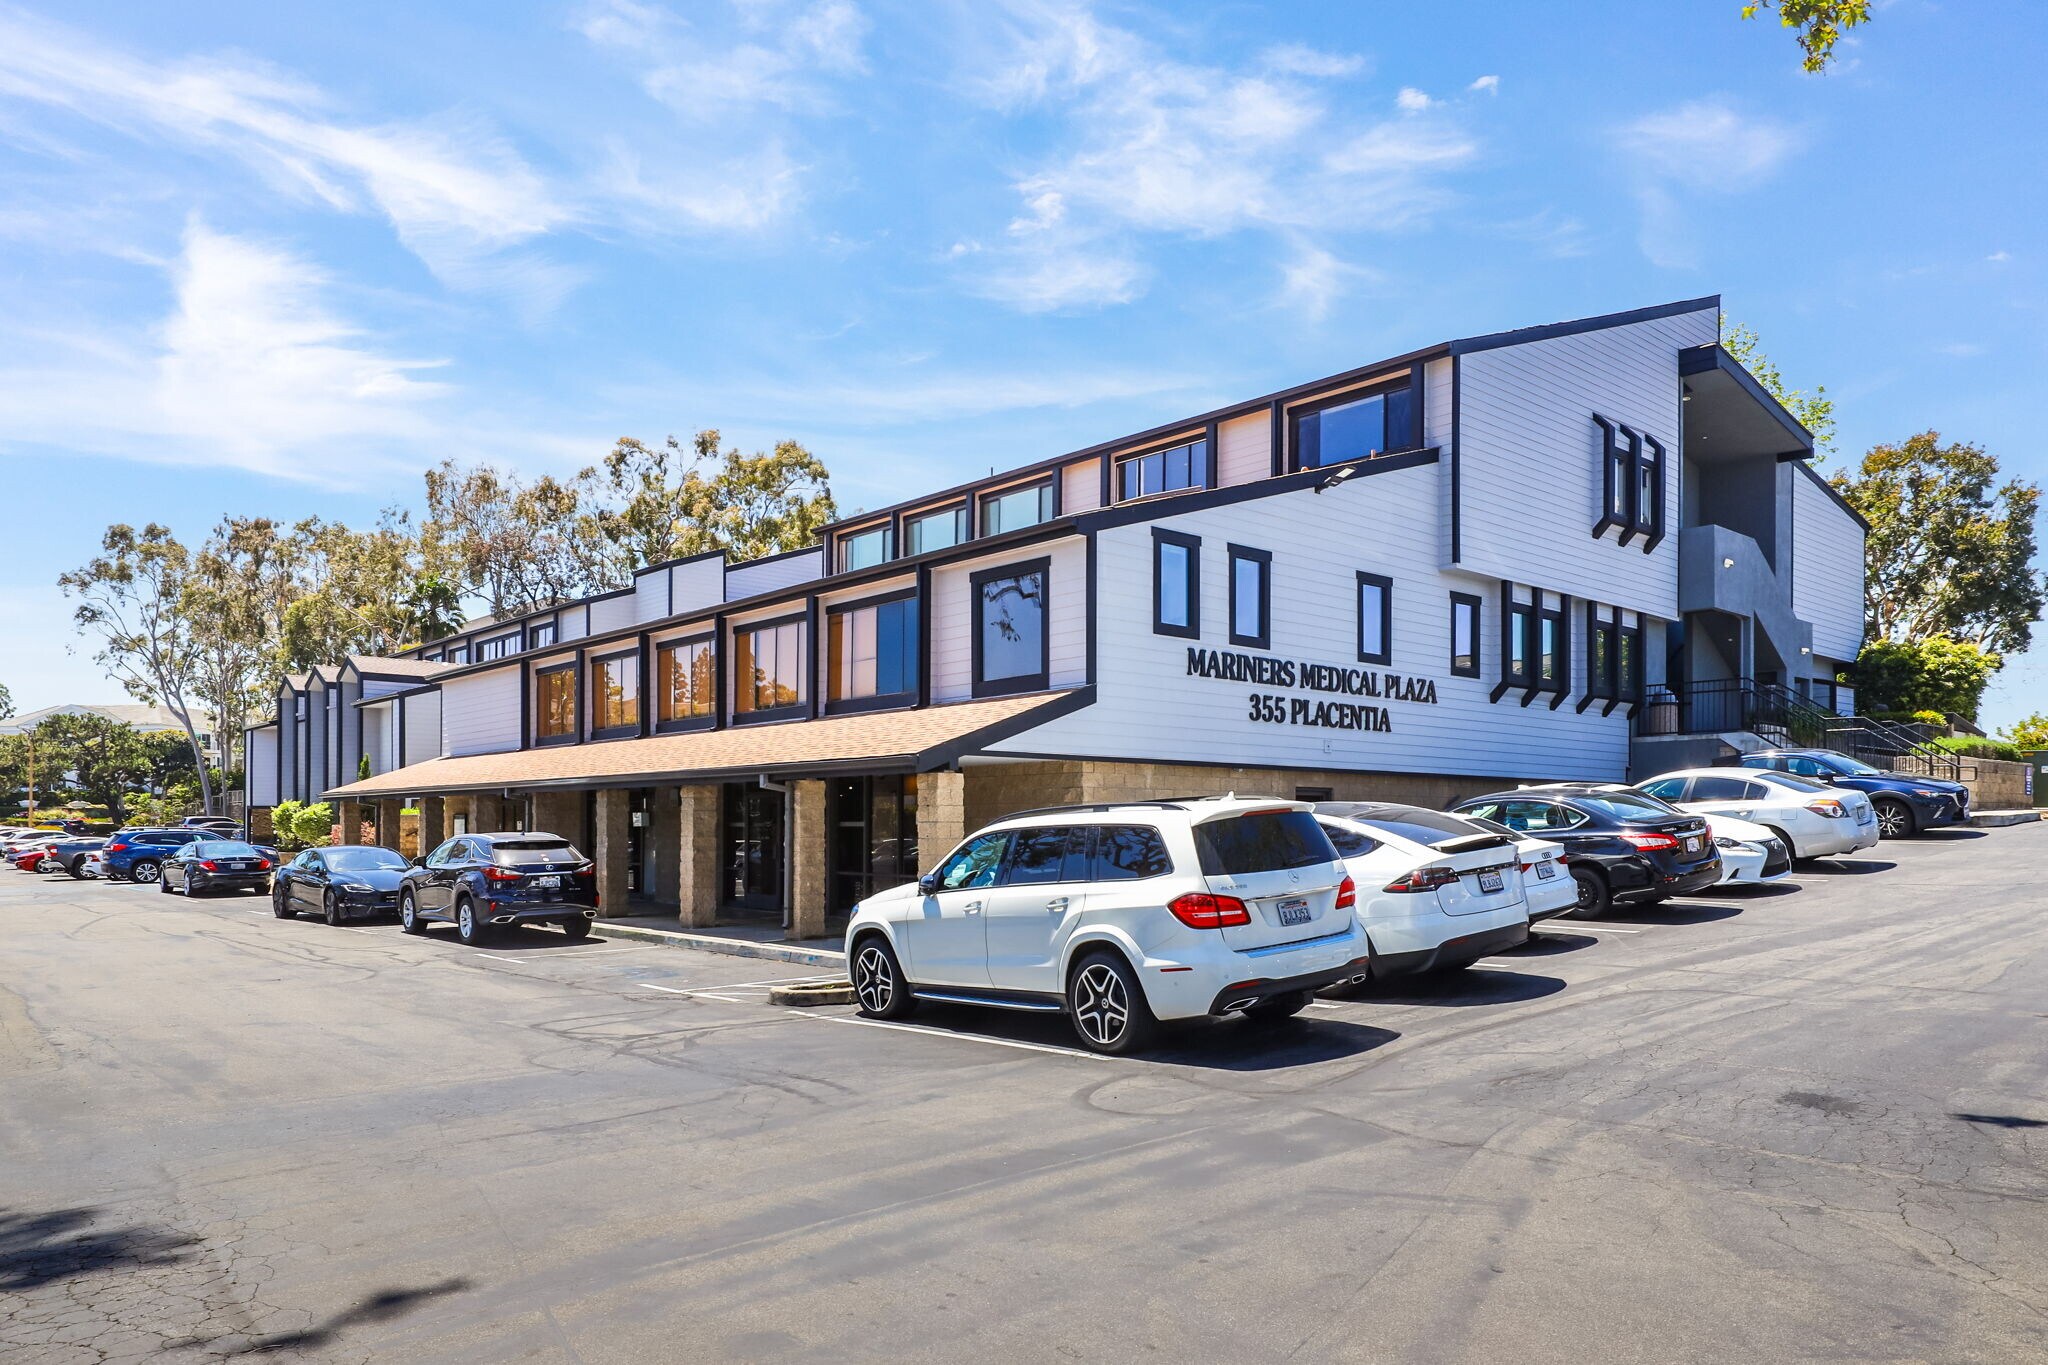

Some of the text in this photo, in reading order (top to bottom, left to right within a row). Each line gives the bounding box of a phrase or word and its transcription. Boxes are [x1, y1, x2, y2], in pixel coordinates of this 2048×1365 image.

[1187, 647, 1438, 704] MARINERS MEDICAL PLAZA
[1248, 693, 1392, 732] 355 PLACENTIA
